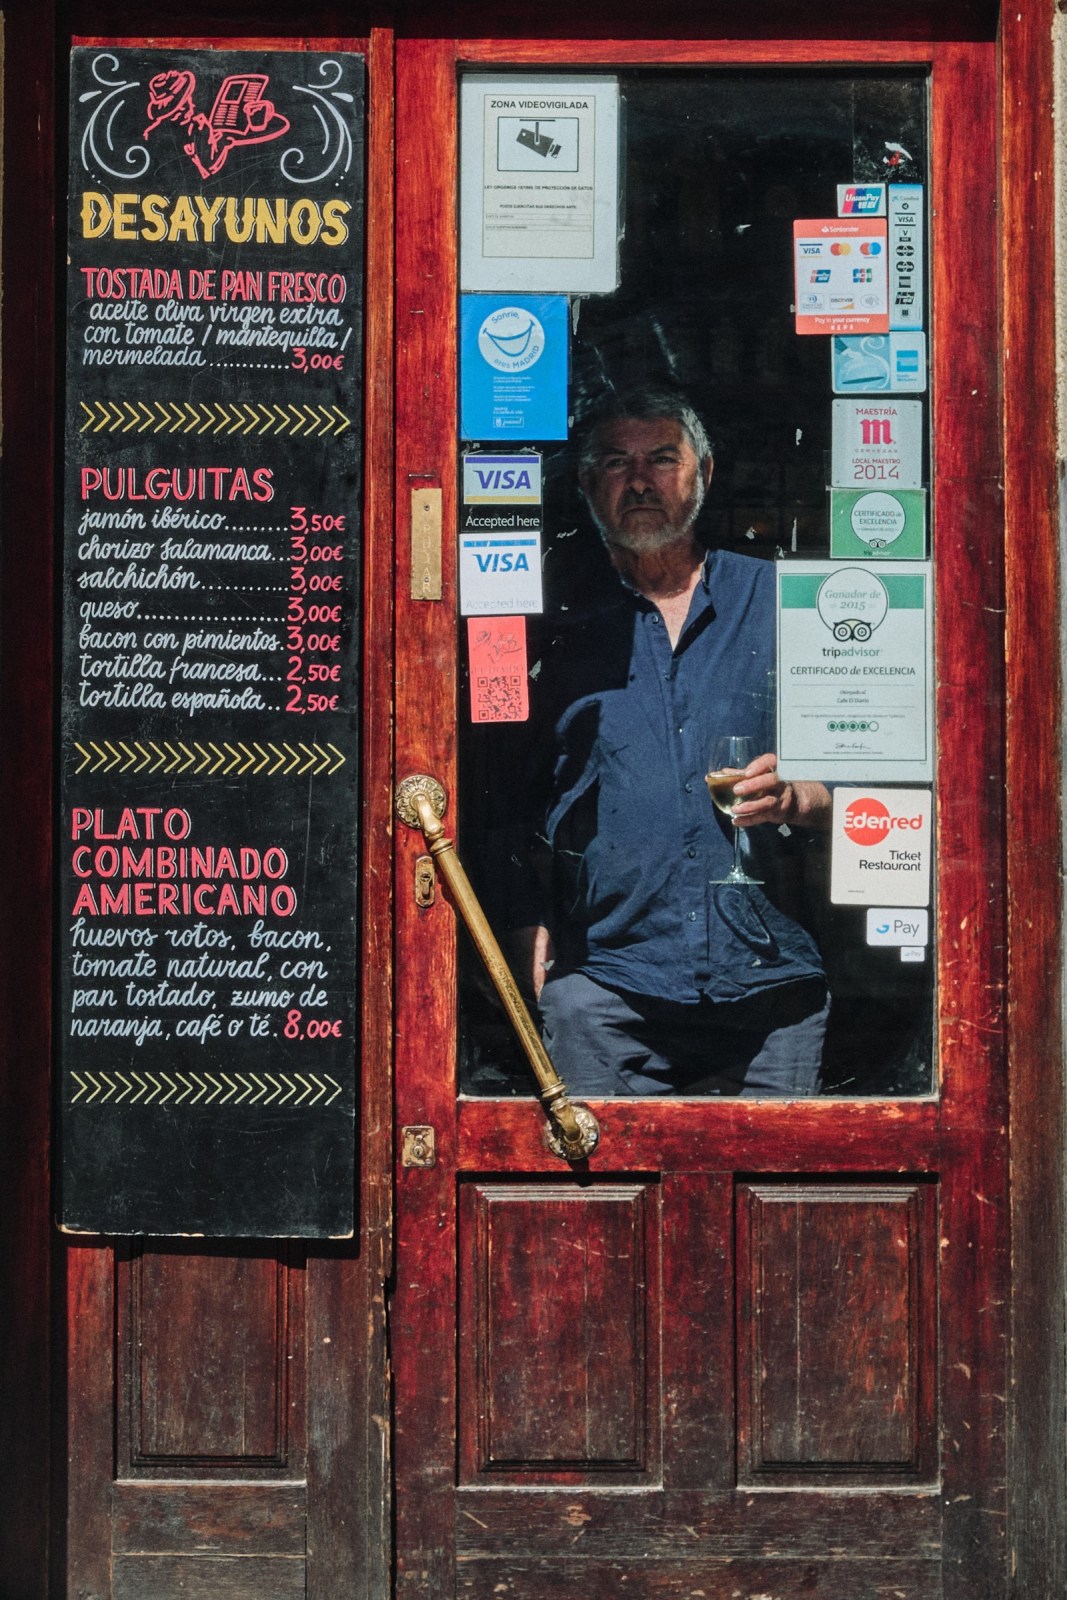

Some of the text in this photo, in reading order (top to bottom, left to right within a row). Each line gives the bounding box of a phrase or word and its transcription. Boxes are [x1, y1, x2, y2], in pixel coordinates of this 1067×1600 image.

[491, 100, 588, 110] ZONA VIDEOVIGILADA
[80, 191, 352, 246] DESAYUNOS
[80, 267, 346, 304] TOSTADA DE PAN FRESCO
[90, 299, 344, 330] aceite oliva virgen extra
[84, 325, 120, 344] con
[125, 321, 195, 344] tomate
[215, 324, 339, 352] mantequilla
[291, 347, 346, 374] 3,00€
[512, 345, 540, 368] MADRID
[856, 406, 898, 416] MAESTRÍA
[81, 467, 274, 502] PULGUITAS
[474, 470, 532, 489] VISA
[854, 464, 899, 480] 2014
[78, 508, 146, 535] jamón
[290, 506, 346, 535] 3,50€
[466, 515, 540, 528] Accepted here
[78, 534, 154, 560] chorizo
[290, 536, 344, 564] 3,00€
[472, 552, 530, 572] VISA
[290, 566, 344, 594] 3,00€
[824, 590, 881, 599] Ganador de
[840, 602, 866, 610] 2015
[287, 596, 342, 624] 3,00€
[79, 623, 137, 650] bacon
[144, 632, 180, 648] con
[286, 626, 342, 654] 3,00€
[822, 646, 880, 659] tripadvisor
[80, 653, 166, 678] tortilla
[286, 656, 342, 685] 2,50€
[790, 666, 916, 676] CERTIFICADO de EXCELENCIA
[79, 680, 166, 708] tortilla
[286, 684, 339, 715] 2,50€
[72, 807, 192, 841] PLATO
[844, 812, 923, 830] Edenred
[72, 845, 288, 880] COMBINADO
[859, 859, 922, 872] Restaurant
[889, 850, 922, 861] Ticket
[72, 882, 298, 917] AMERICANO
[70, 917, 332, 951] huevos rotos, bacon,
[72, 950, 328, 982] tomate natural, con
[72, 980, 328, 1012] pan tostado, zumo de
[70, 1016, 170, 1046] naranja,
[176, 1014, 223, 1044] café
[228, 1020, 244, 1037] o
[283, 1008, 342, 1041] 8,00€
